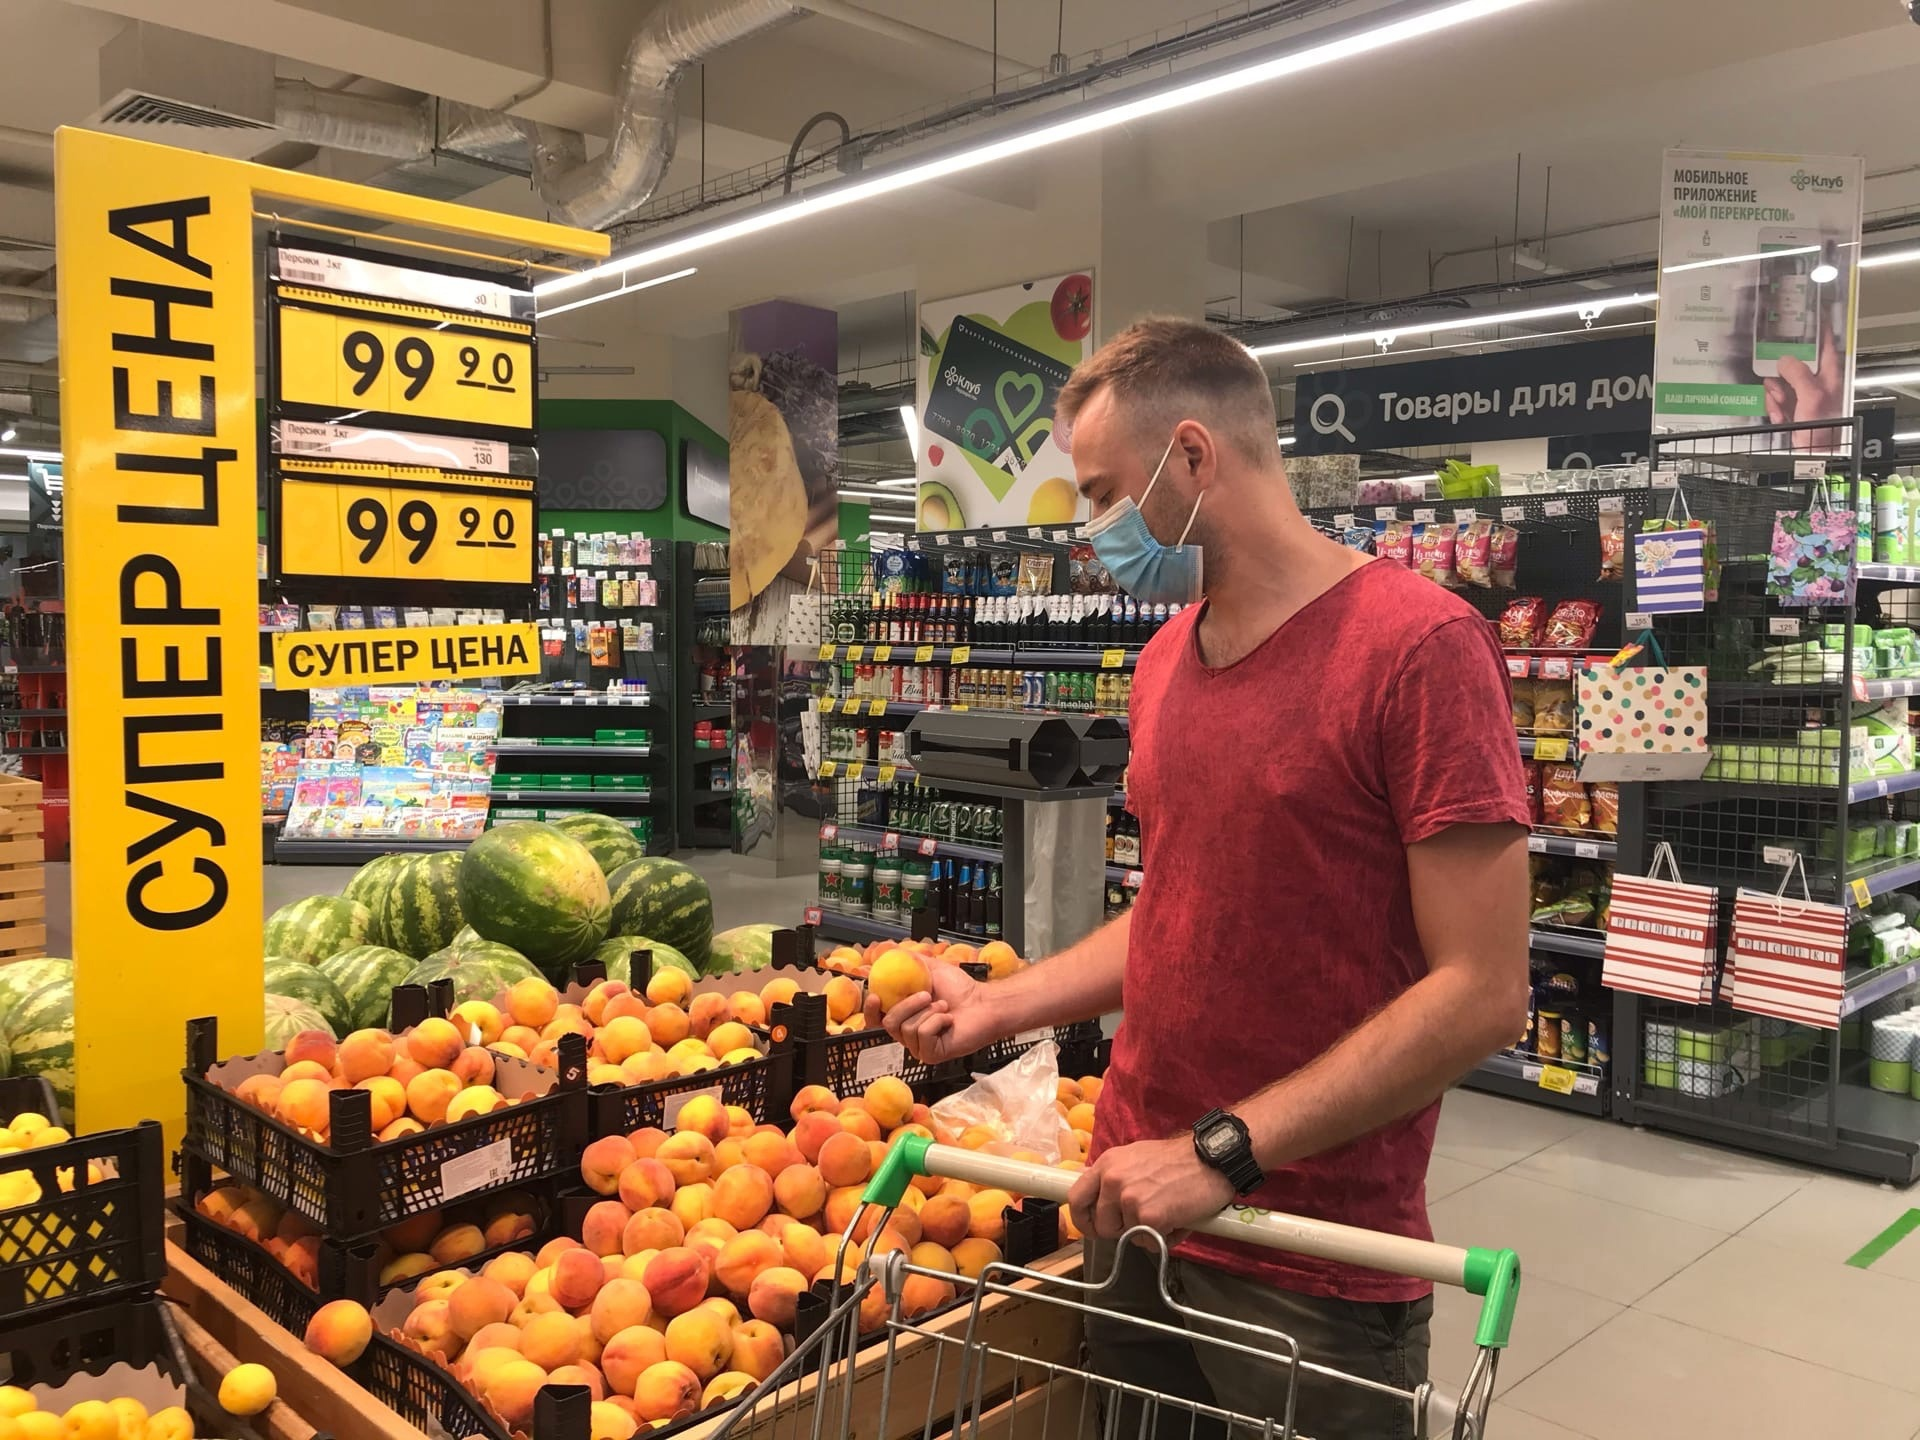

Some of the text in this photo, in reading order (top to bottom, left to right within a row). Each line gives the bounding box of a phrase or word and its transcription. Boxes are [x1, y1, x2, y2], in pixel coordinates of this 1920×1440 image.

[1673, 169, 1749, 185] МОБИЛЬНОЕ
[1811, 174, 1844, 189] Клуб
[1673, 187, 1758, 203] ПРИЛОЖЕНИЕ
[1673, 203, 1796, 221] «МОЙ ПЕРЕКРЕСТОК»
[343, 330, 514, 401] 99 90
[958, 375, 982, 395] Клуб
[1378, 389, 1501, 425] Товары
[1508, 382, 1577, 417] для
[1664, 393, 1684, 404] ВАШ
[1684, 393, 1719, 404] ЛИЧНЫЙ
[288, 422, 349, 440] Персики 1кг
[473, 452, 493, 465] 130
[346, 497, 514, 564] 99 90
[108, 196, 238, 931] СУПЕР ЦЕНА
[288, 634, 529, 678] СУПЕР ЦЕНА
